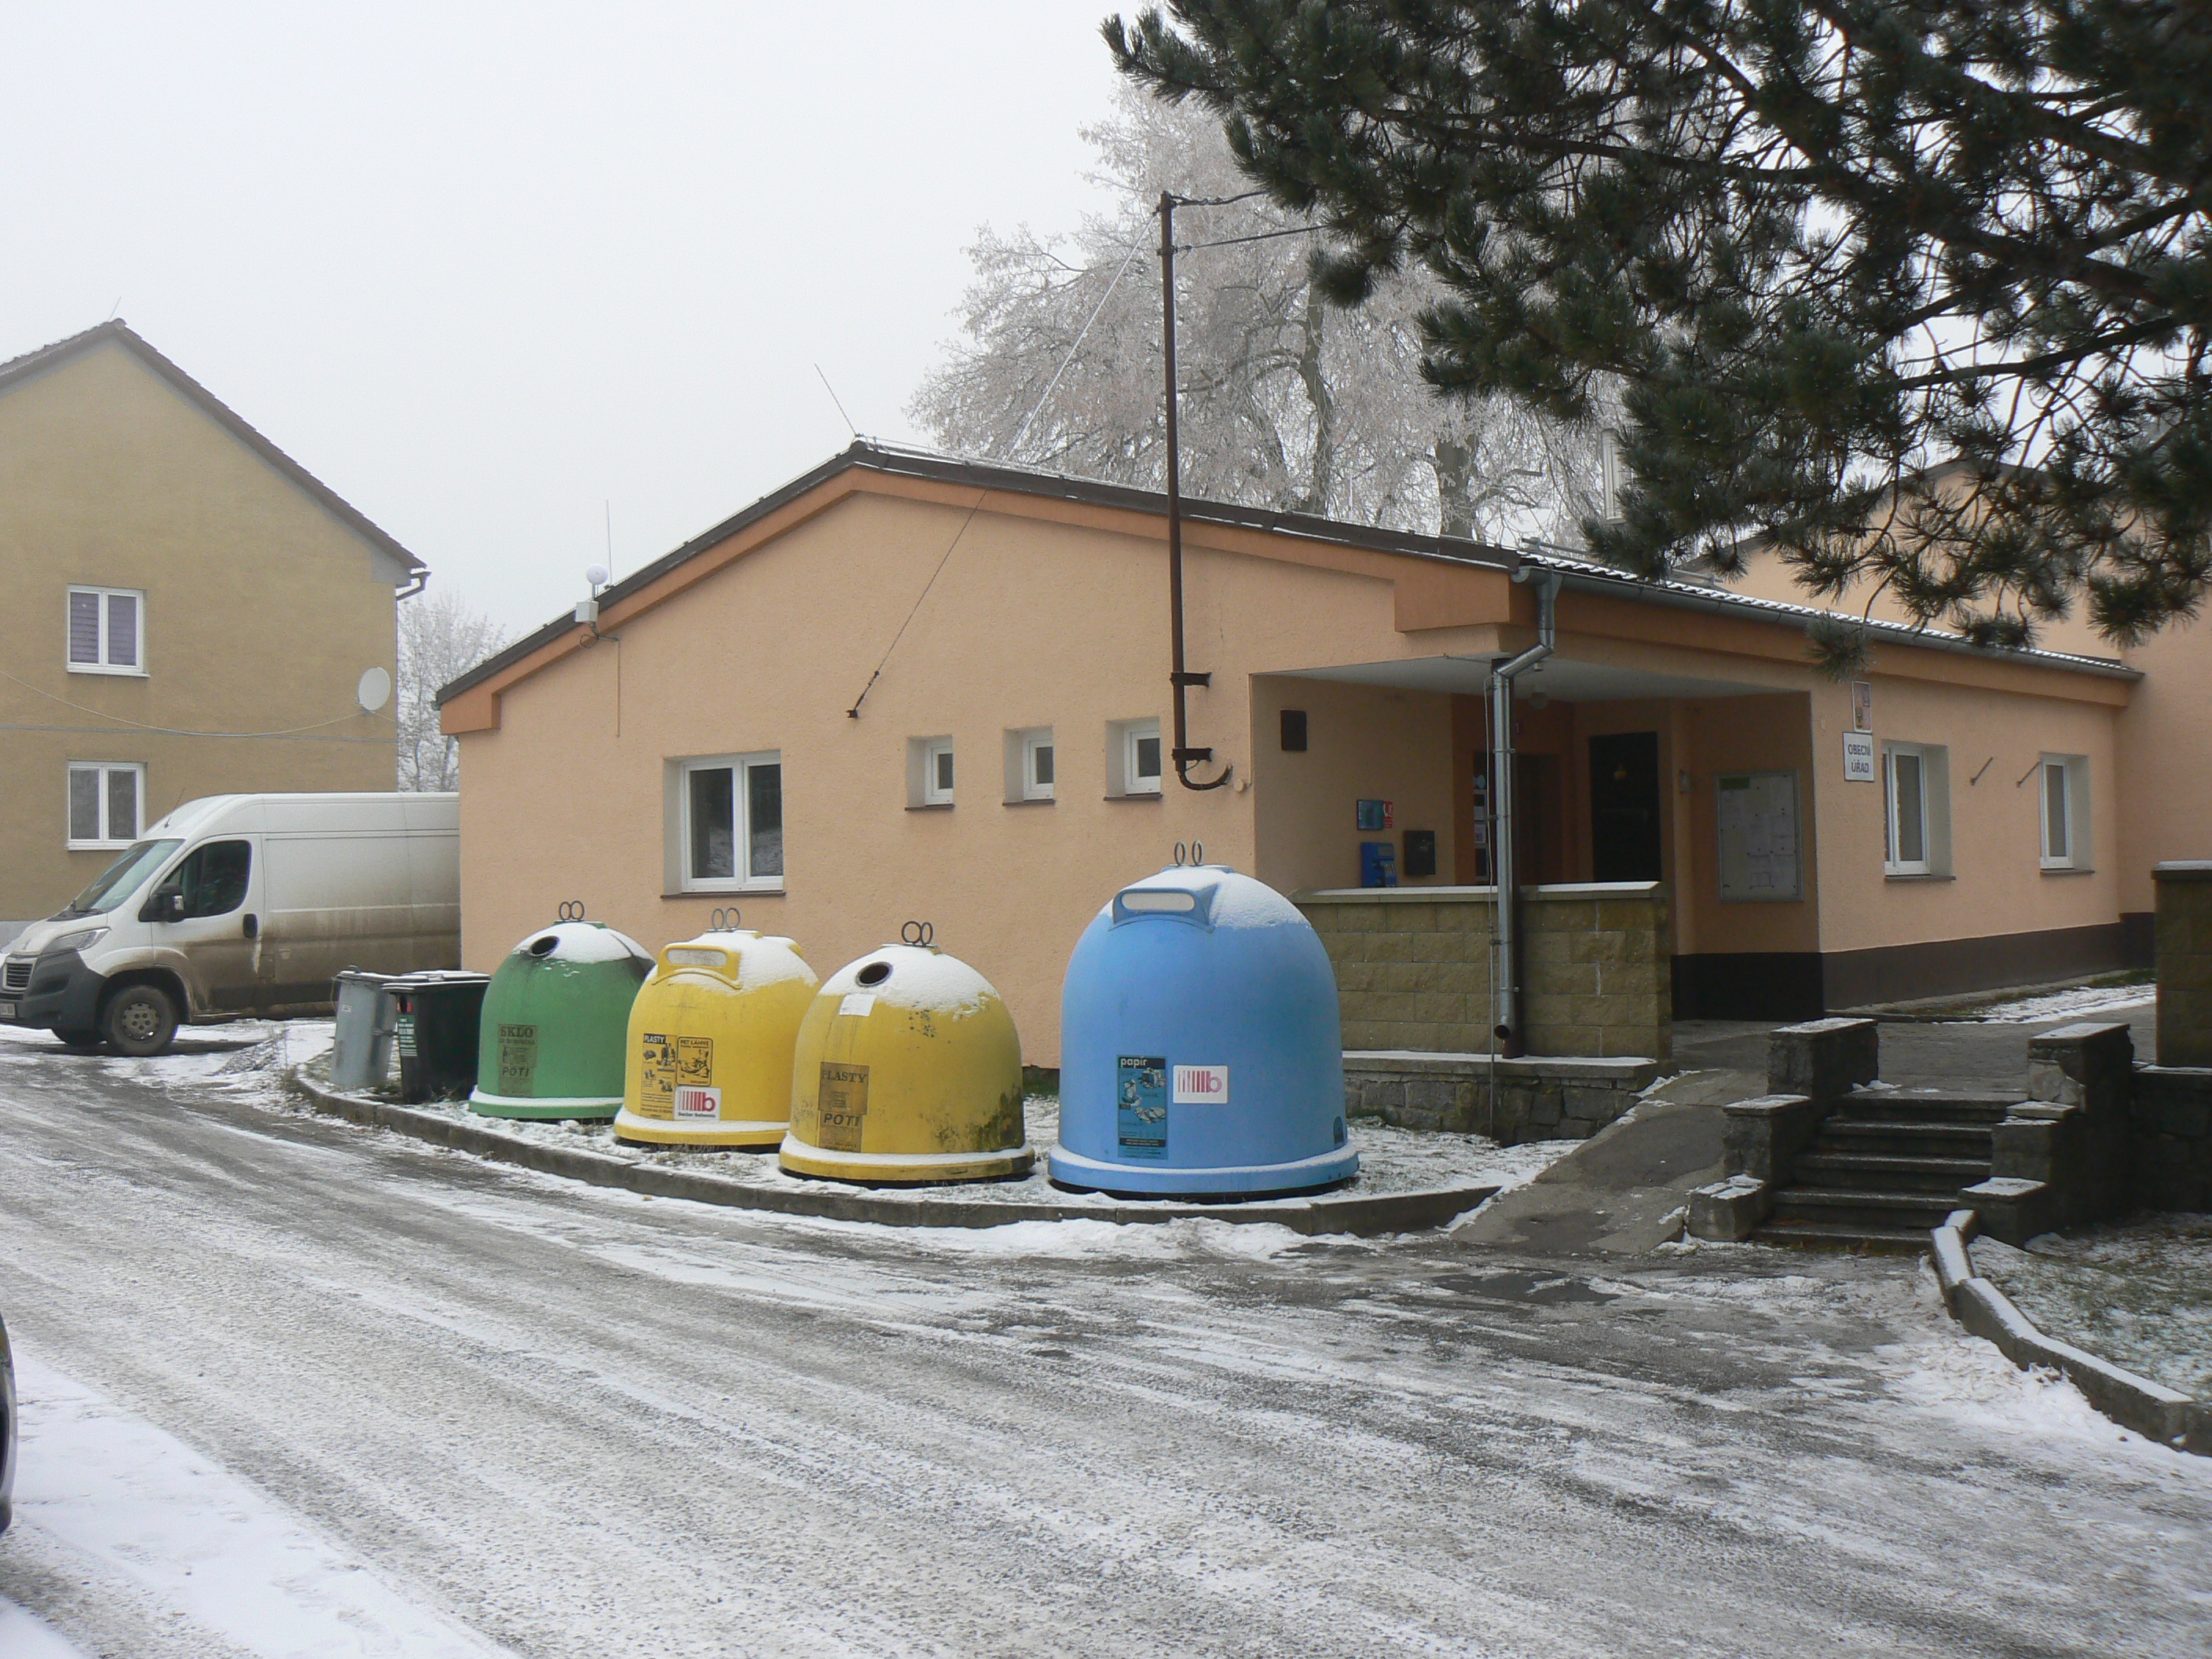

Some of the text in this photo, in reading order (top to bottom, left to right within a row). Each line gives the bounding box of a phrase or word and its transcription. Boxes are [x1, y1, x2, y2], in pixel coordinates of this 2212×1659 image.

[1848, 743, 1871, 756] OBECNÍ
[1851, 759, 1870, 773] ÚŘAD
[500, 1026, 533, 1038] SKLO
[644, 1035, 665, 1044] PLASTY
[1120, 1056, 1148, 1068] papír
